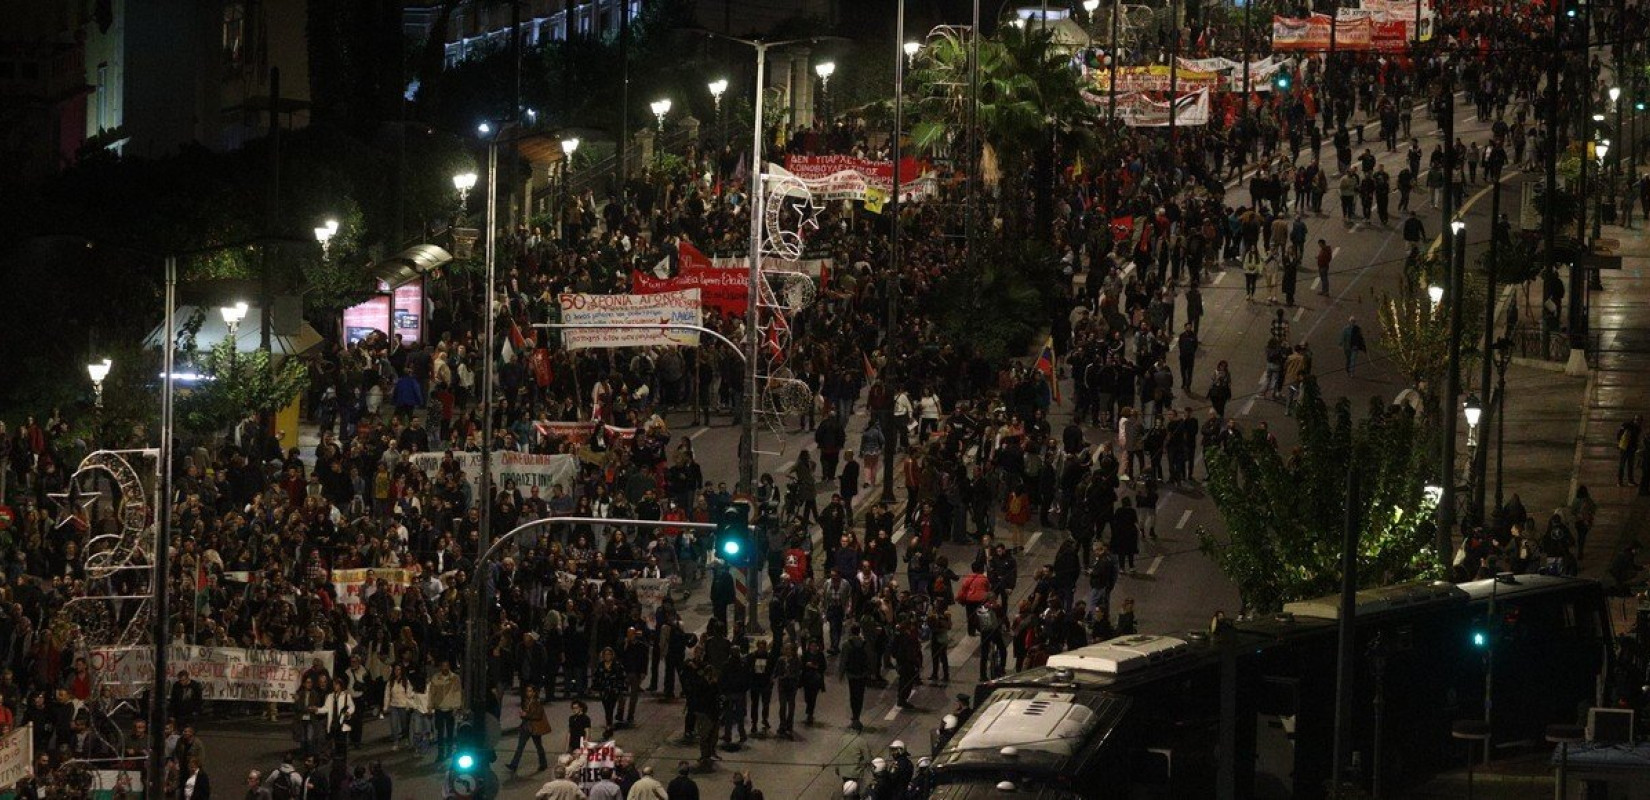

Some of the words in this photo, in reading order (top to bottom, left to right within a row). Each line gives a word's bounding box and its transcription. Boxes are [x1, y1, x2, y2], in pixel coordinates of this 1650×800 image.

[791, 154, 808, 164] ΔΕΝ
[560, 294, 586, 310] 50
[469, 454, 494, 467] ΧΩΣ
